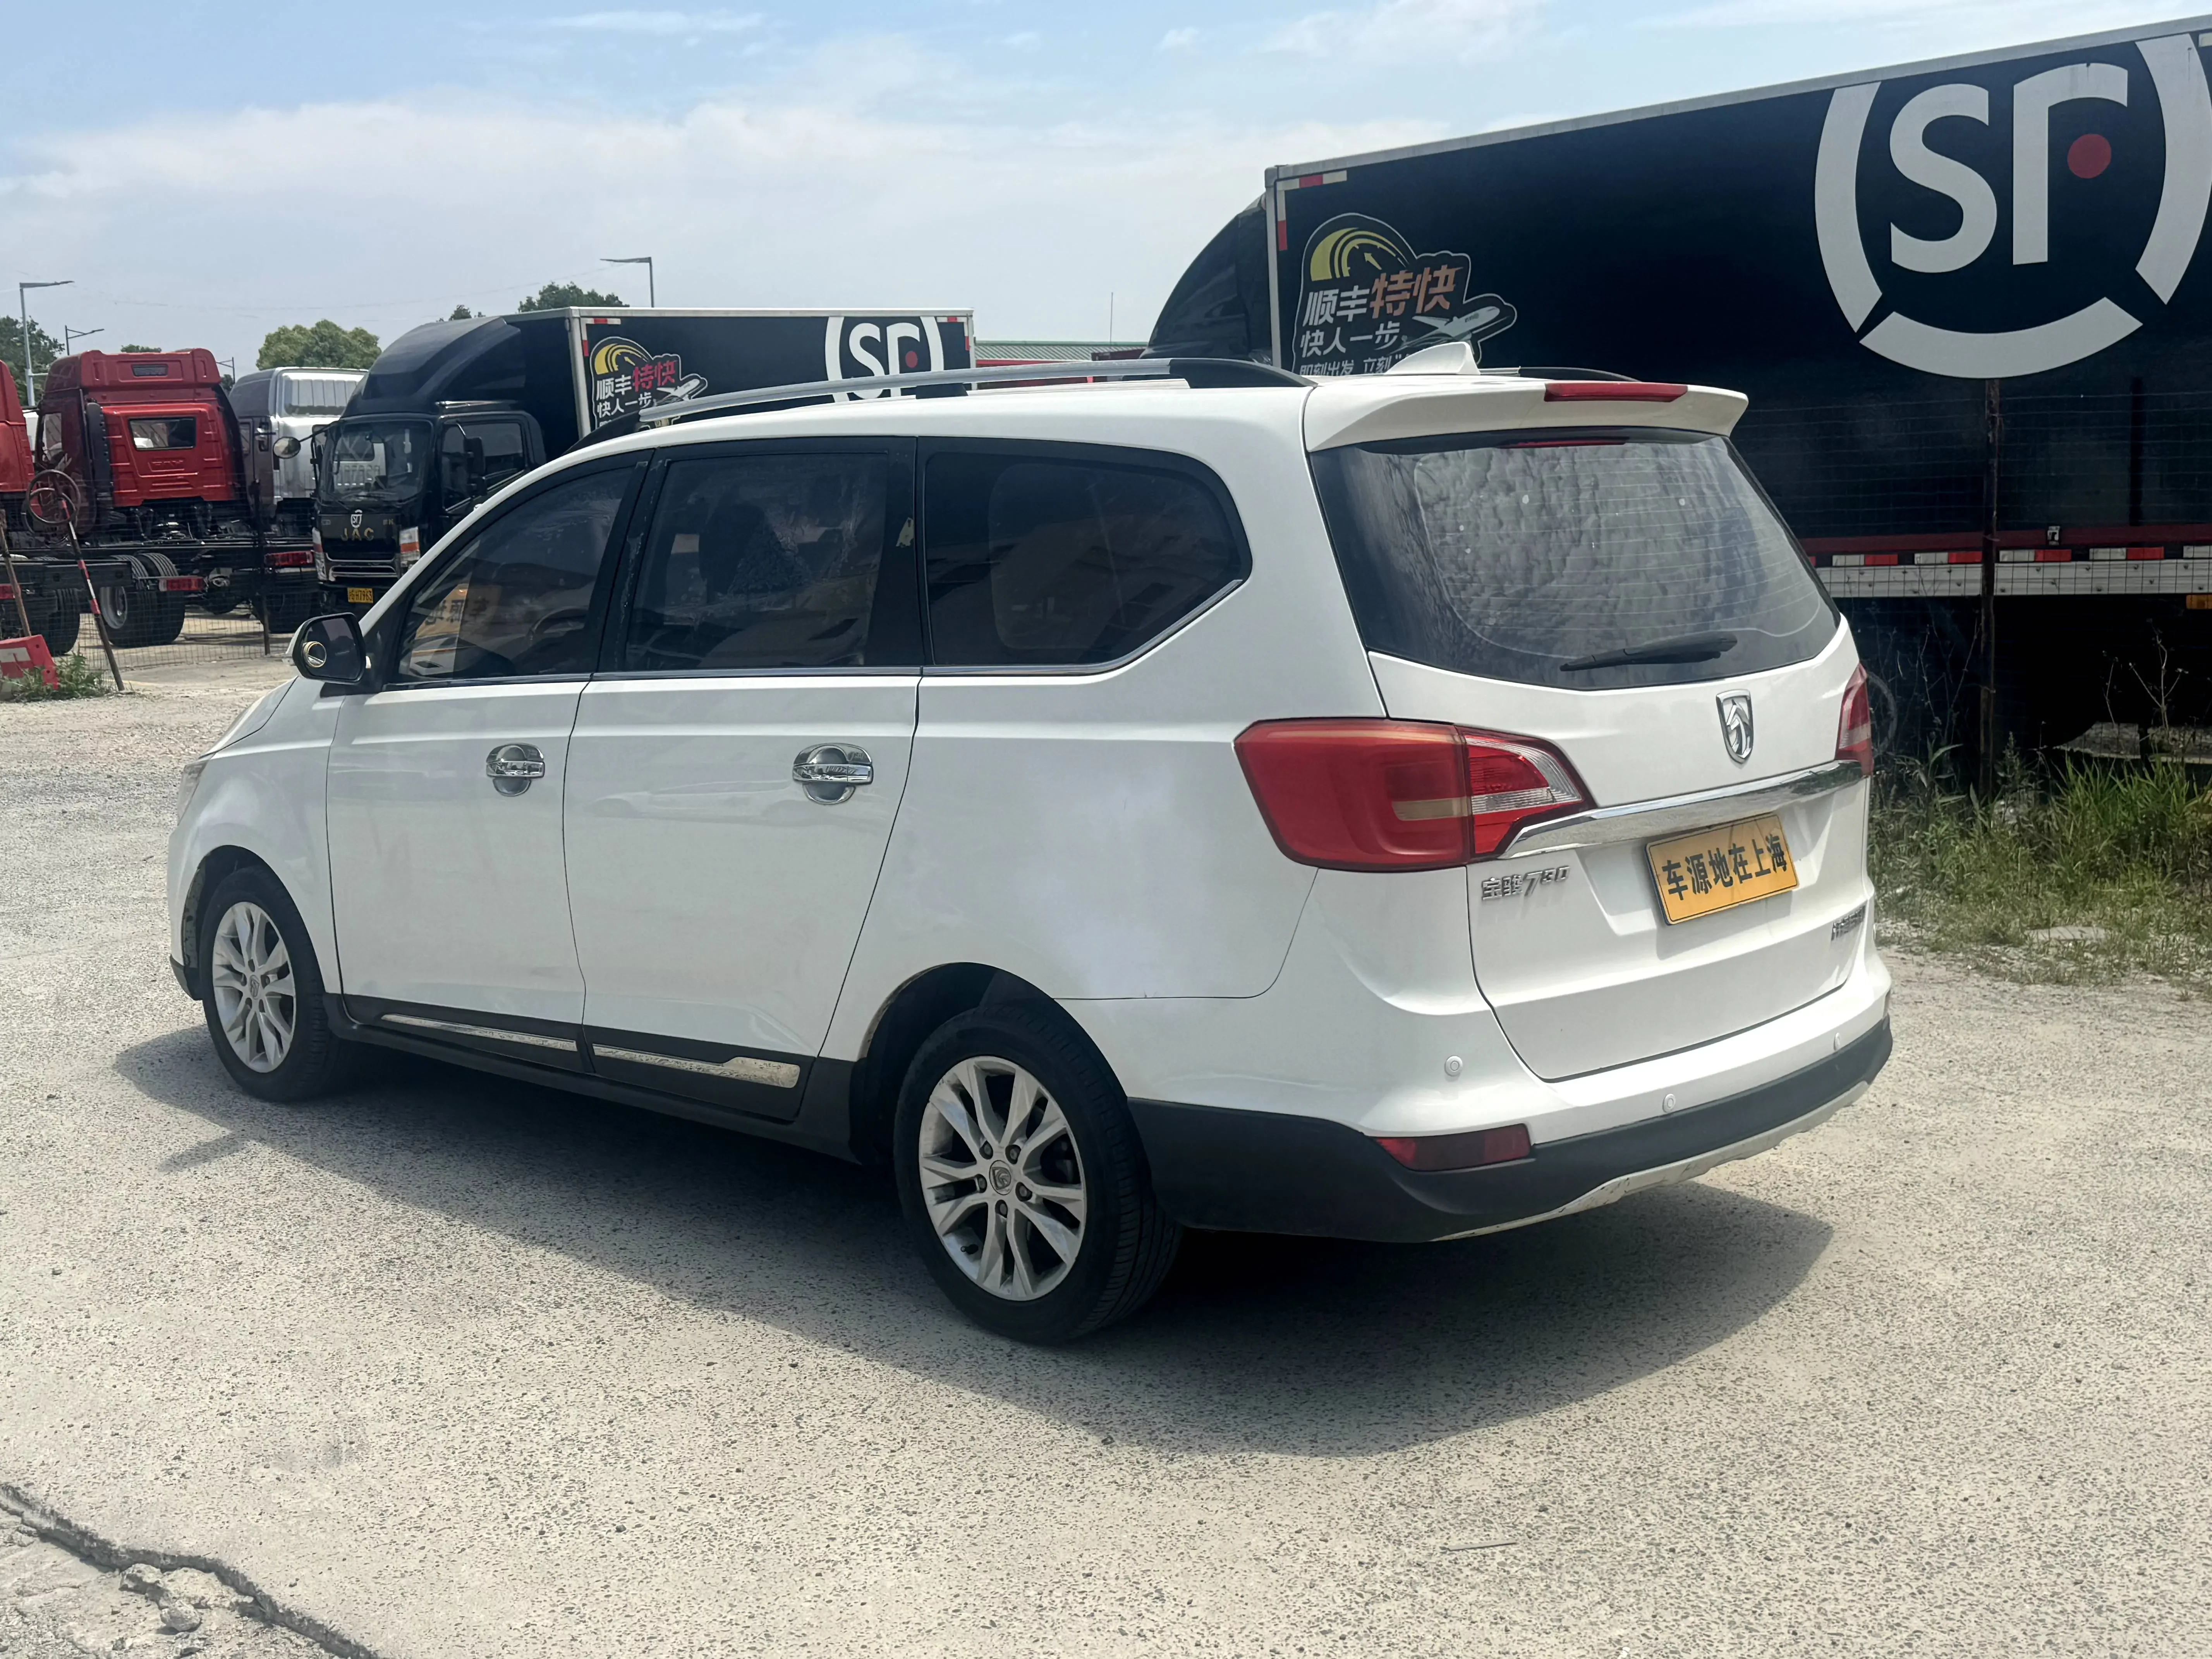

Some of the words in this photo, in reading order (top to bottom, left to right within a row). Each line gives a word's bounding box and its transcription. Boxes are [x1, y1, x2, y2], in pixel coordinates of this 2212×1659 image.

[1303, 264, 1463, 326] 顺丰特快
[1300, 321, 1400, 357] 快人一步
[596, 360, 678, 401] 顺丰特快
[597, 392, 652, 418] 快人一步
[340, 527, 374, 541] JAC
[1661, 834, 1787, 900] 车源地在上海
